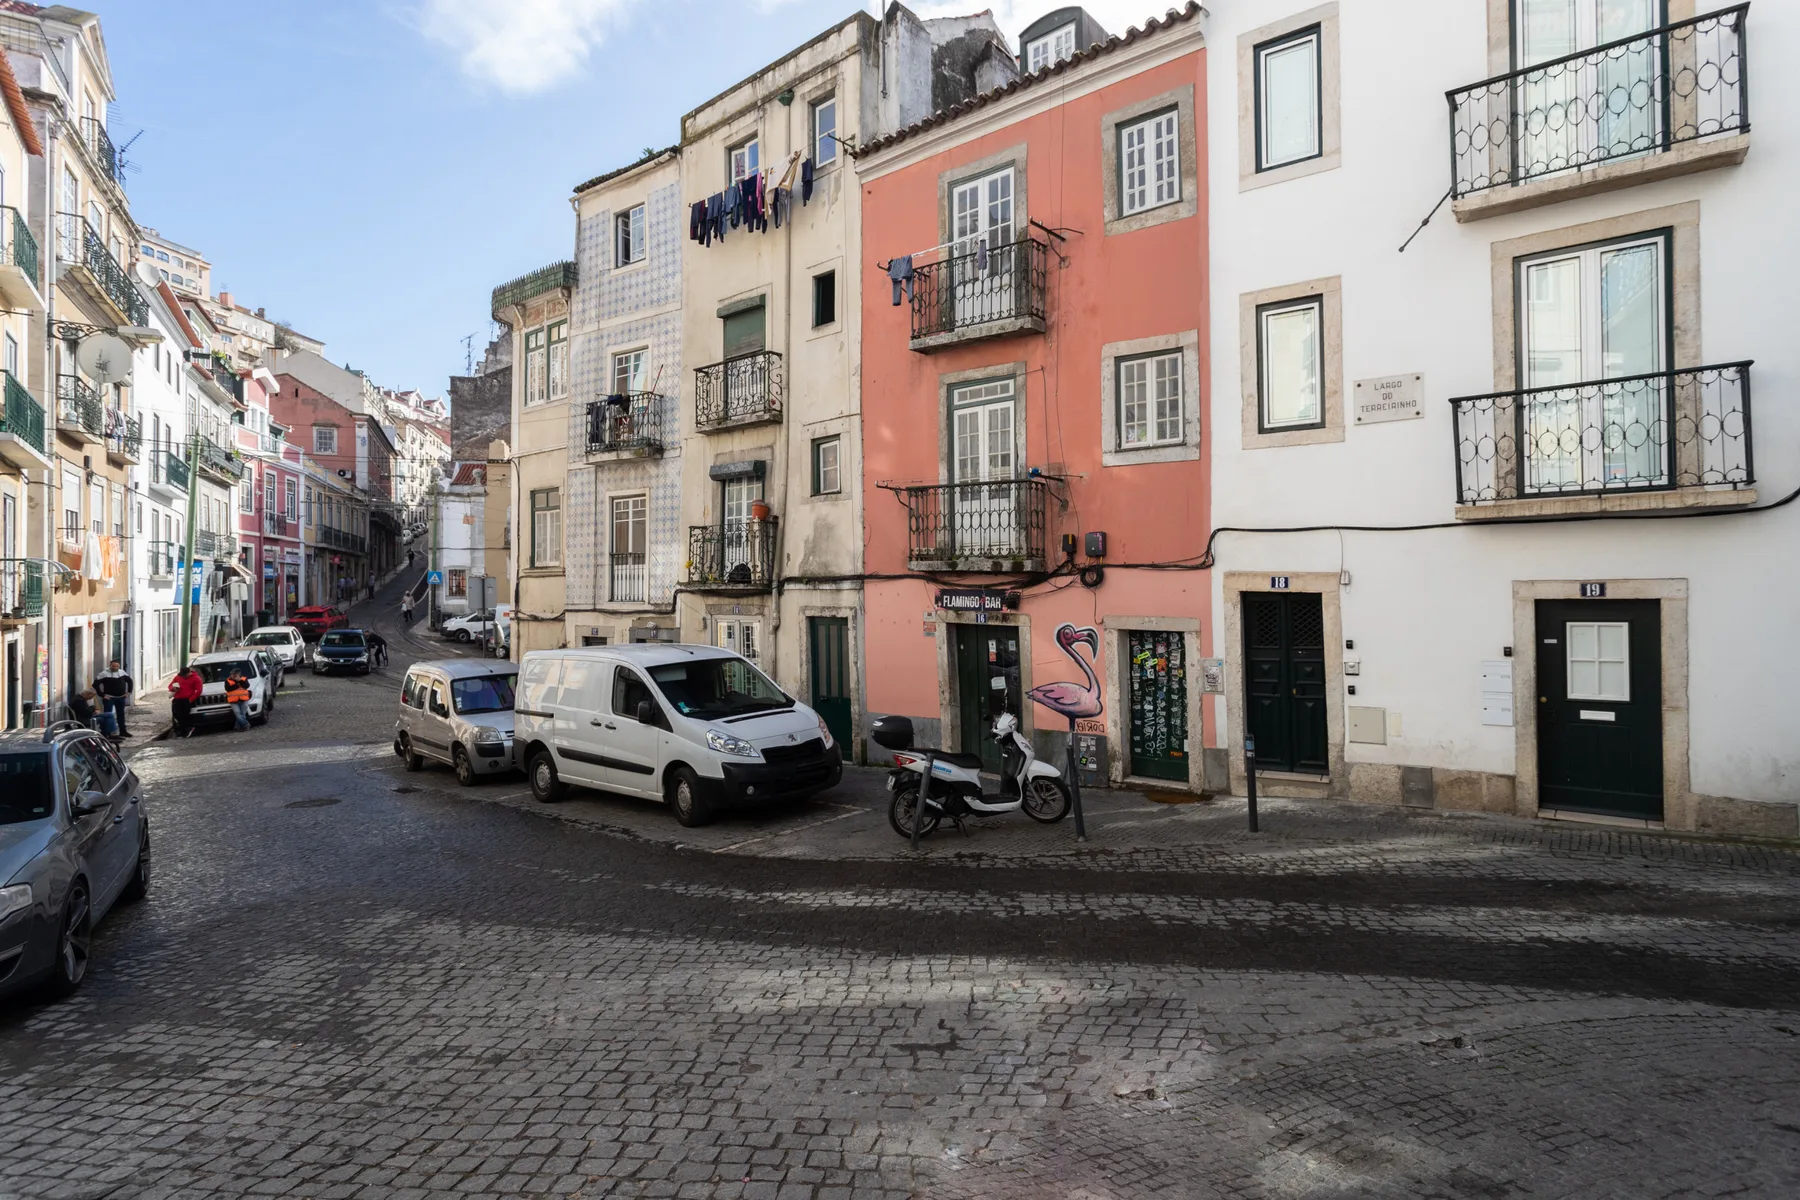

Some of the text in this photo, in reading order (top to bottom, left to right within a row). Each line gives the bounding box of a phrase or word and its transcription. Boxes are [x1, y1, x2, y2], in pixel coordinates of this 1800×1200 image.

[1374, 381, 1402, 390] LARGO
[1382, 392, 1393, 400] DO
[1360, 400, 1417, 412] TERREIRINHO
[1274, 577, 1286, 588] 18
[1586, 583, 1600, 597] 19
[985, 596, 1001, 609] BAR
[977, 614, 985, 623] 16
